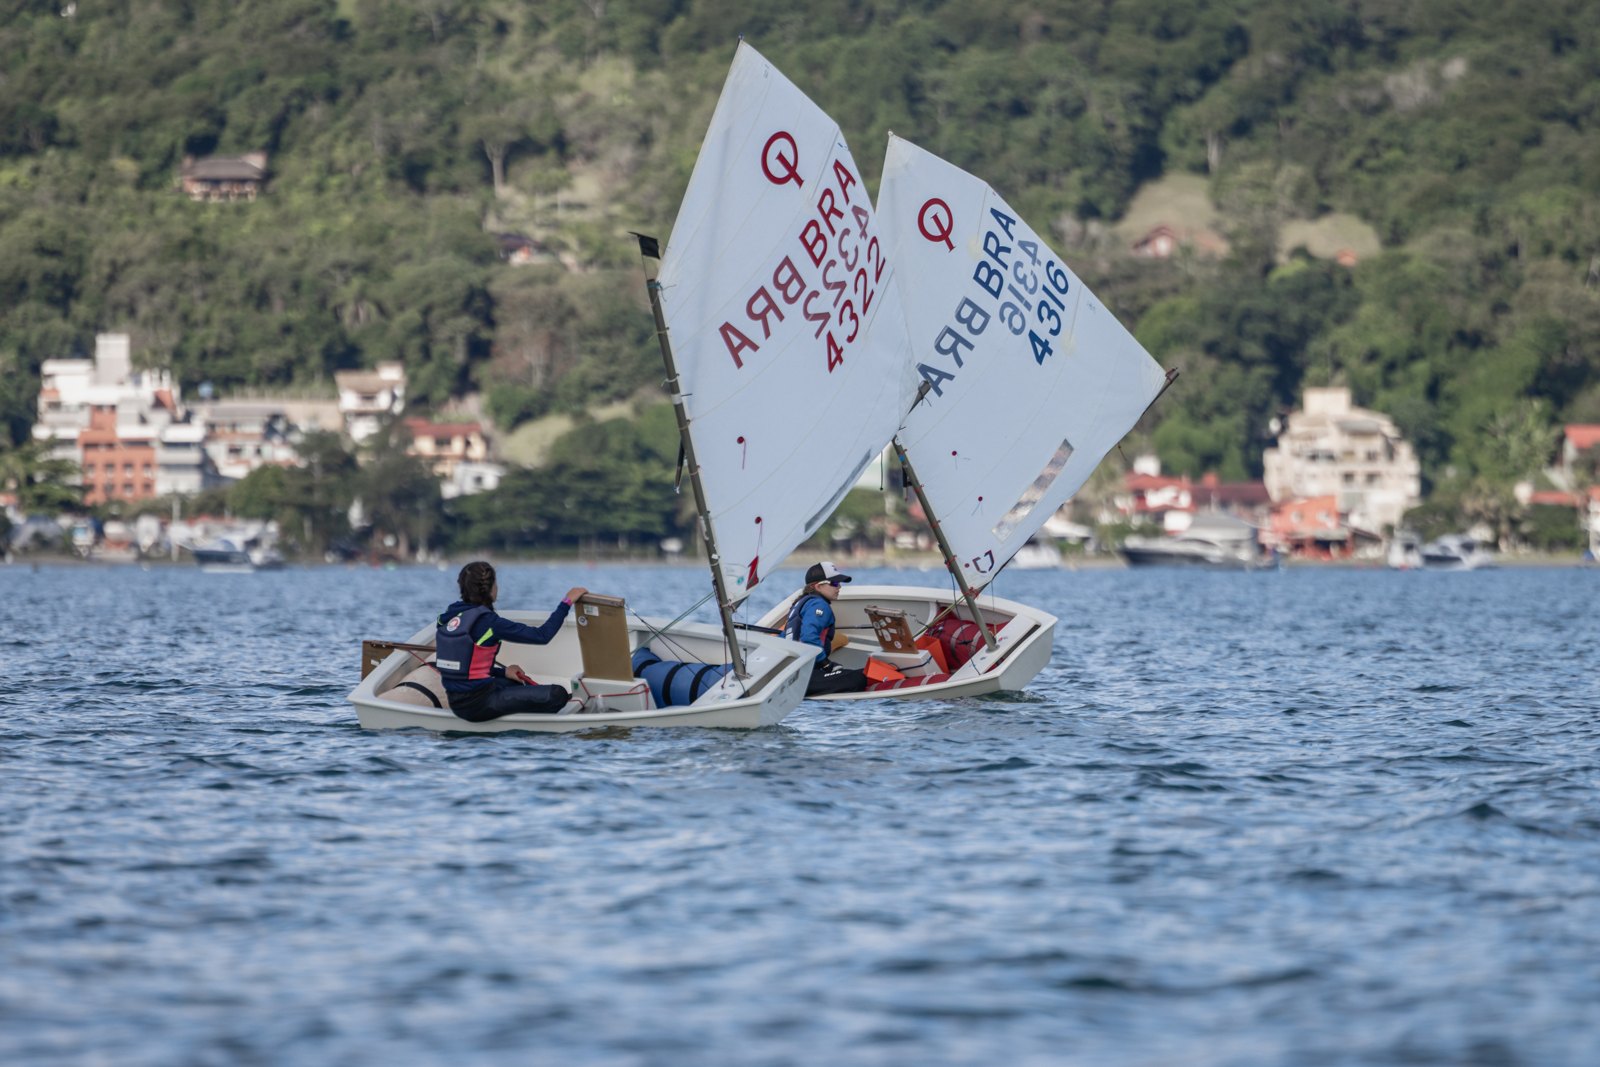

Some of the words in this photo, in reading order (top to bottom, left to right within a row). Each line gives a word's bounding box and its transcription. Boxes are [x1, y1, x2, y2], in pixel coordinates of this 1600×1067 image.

[799, 159, 856, 268] BRA
[973, 207, 1016, 300] BRA
[826, 236, 886, 373] 4322
[1028, 260, 1069, 366] 4316
